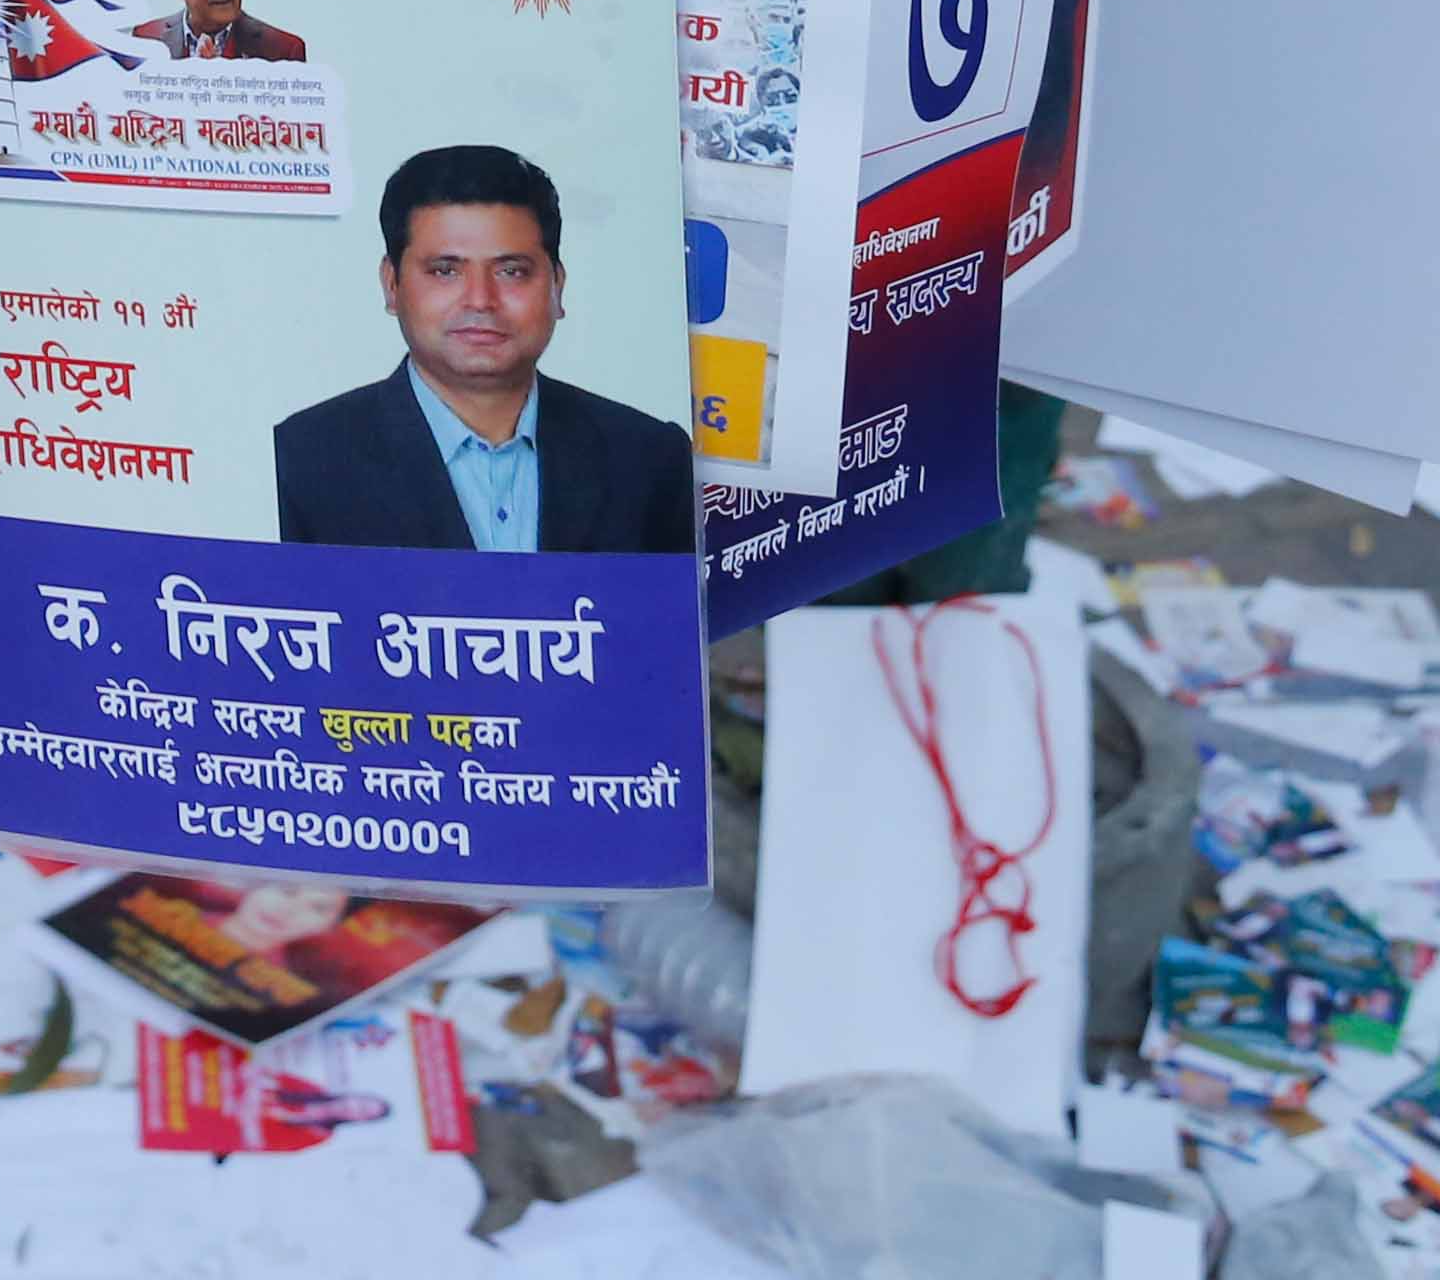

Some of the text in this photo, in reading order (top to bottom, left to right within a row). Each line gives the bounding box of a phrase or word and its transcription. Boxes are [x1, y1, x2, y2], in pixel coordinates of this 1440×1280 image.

[51, 152, 83, 168] CPN
[88, 152, 139, 171] (UML)
[167, 157, 244, 176] NATIONAL
[248, 161, 330, 178] CONGRESS
[852, 217, 940, 269] हाधिवेशनमा
[0, 288, 100, 322] एमालेको
[114, 300, 146, 327] ११
[162, 294, 198, 330] औं
[886, 251, 984, 325] सदस्य
[722, 519, 790, 579] बहुमतले
[797, 496, 847, 543] विजय
[854, 465, 910, 515] गराऔं
[37, 573, 606, 685] क. निरज आचार्य
[96, 680, 520, 754] केन्द्रिय सदस्य खुल्ला पदका
[194, 748, 348, 796] अत्याधिक
[362, 760, 445, 807] मतले
[459, 762, 554, 808] विजय
[570, 762, 682, 814] गराऔं
[177, 800, 471, 857] ९८५१२००००१
